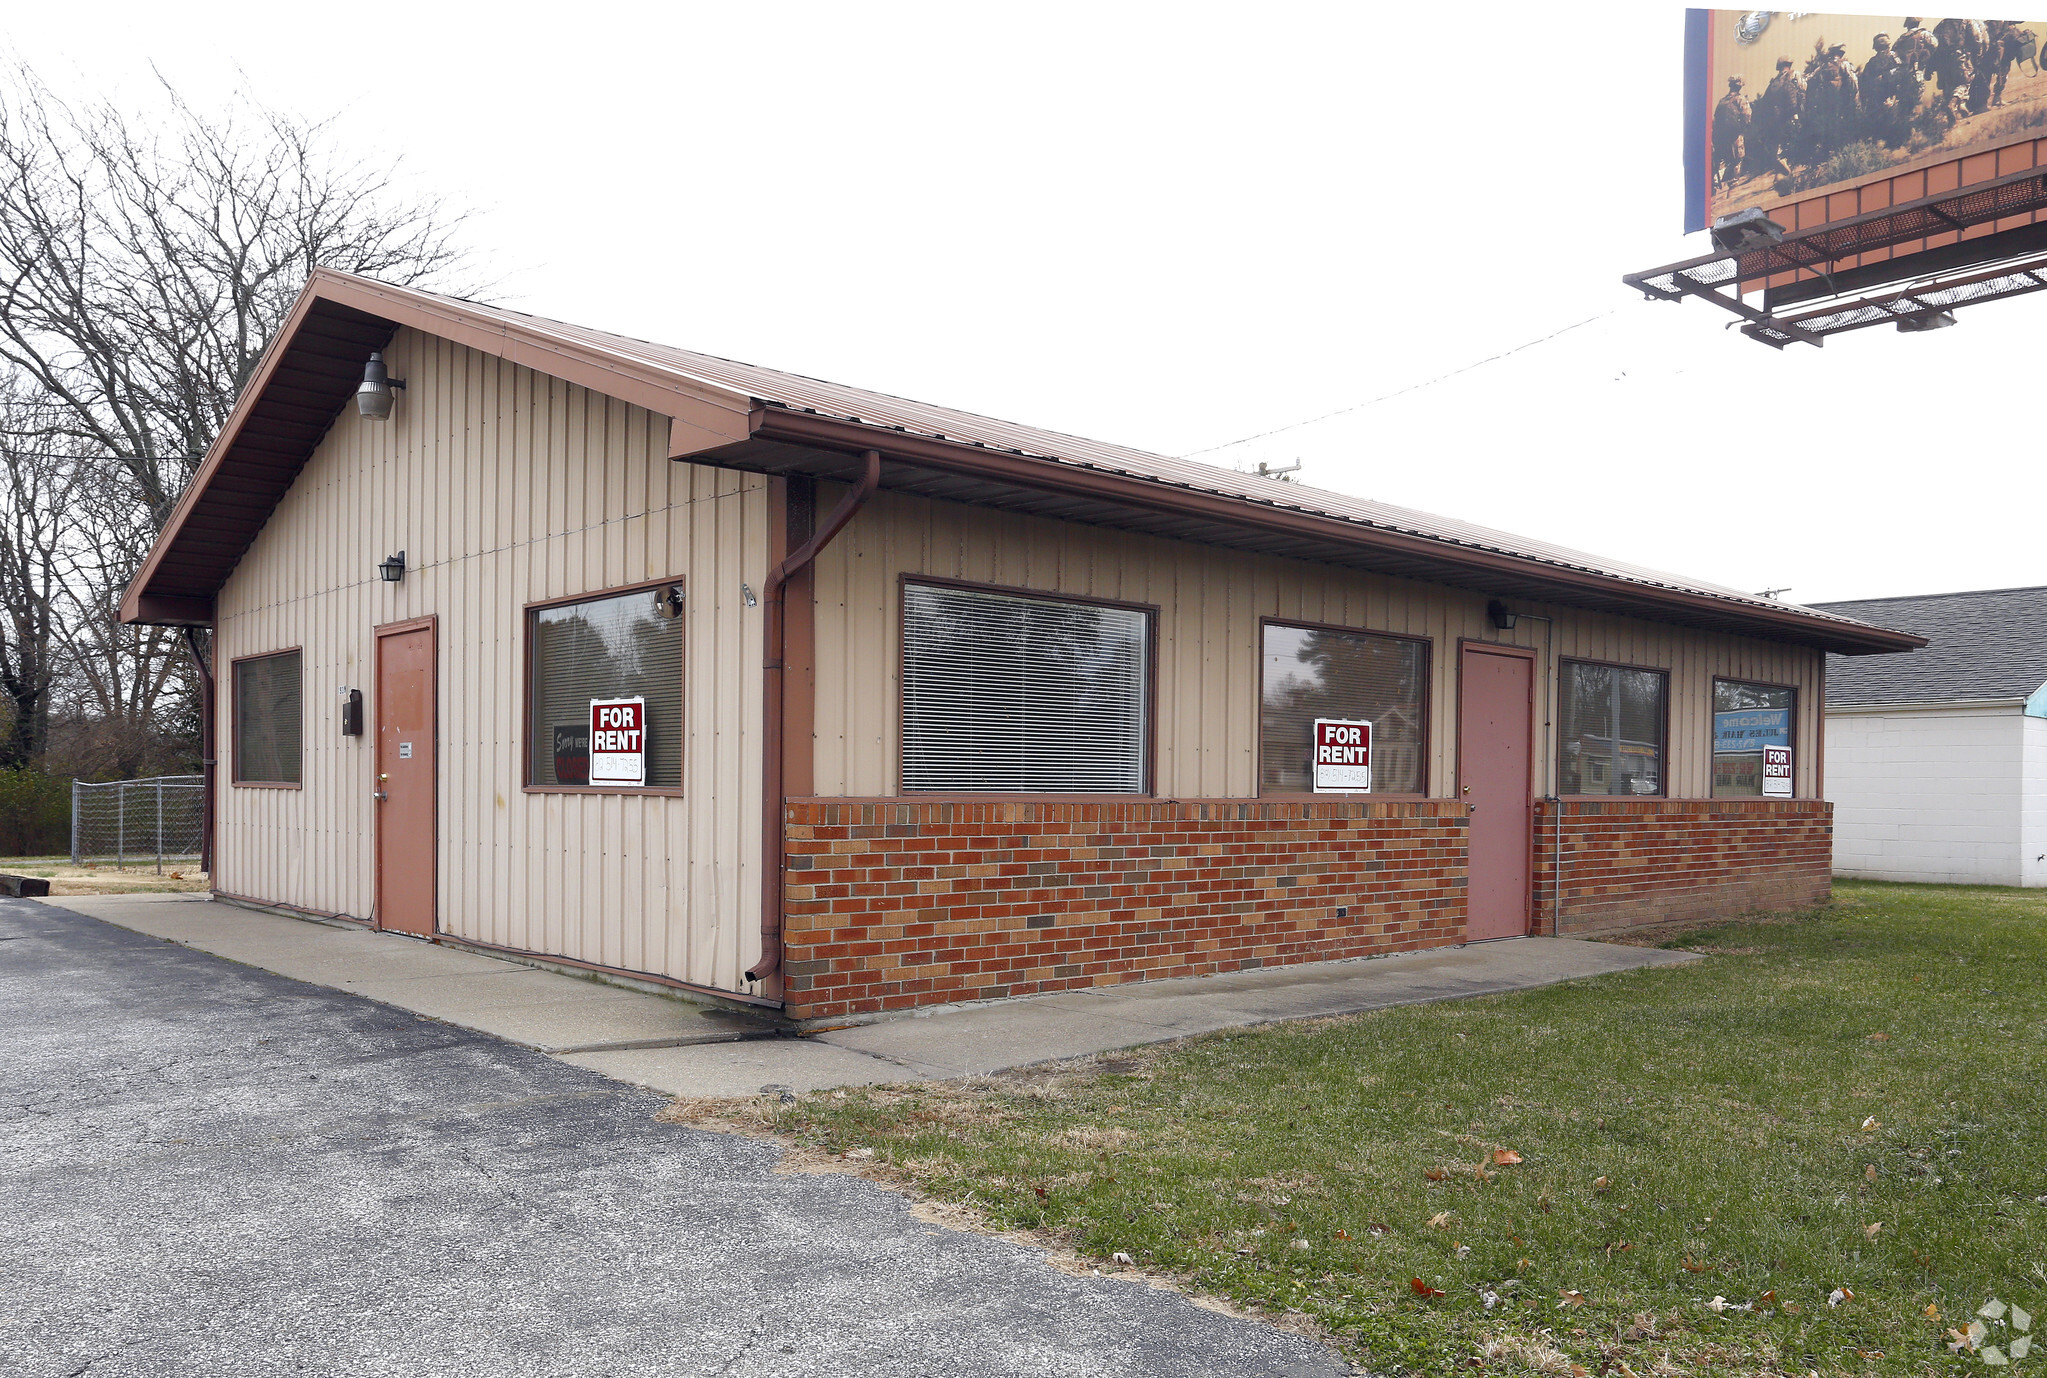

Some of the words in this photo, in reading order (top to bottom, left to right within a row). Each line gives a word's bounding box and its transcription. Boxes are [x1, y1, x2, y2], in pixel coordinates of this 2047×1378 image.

[600, 707, 634, 728] FOR
[594, 730, 640, 751] RENT
[1325, 726, 1361, 745] FOR
[1319, 745, 1367, 764] RENT
[1768, 751, 1787, 763] FOR
[1765, 764, 1790, 776] RENT
